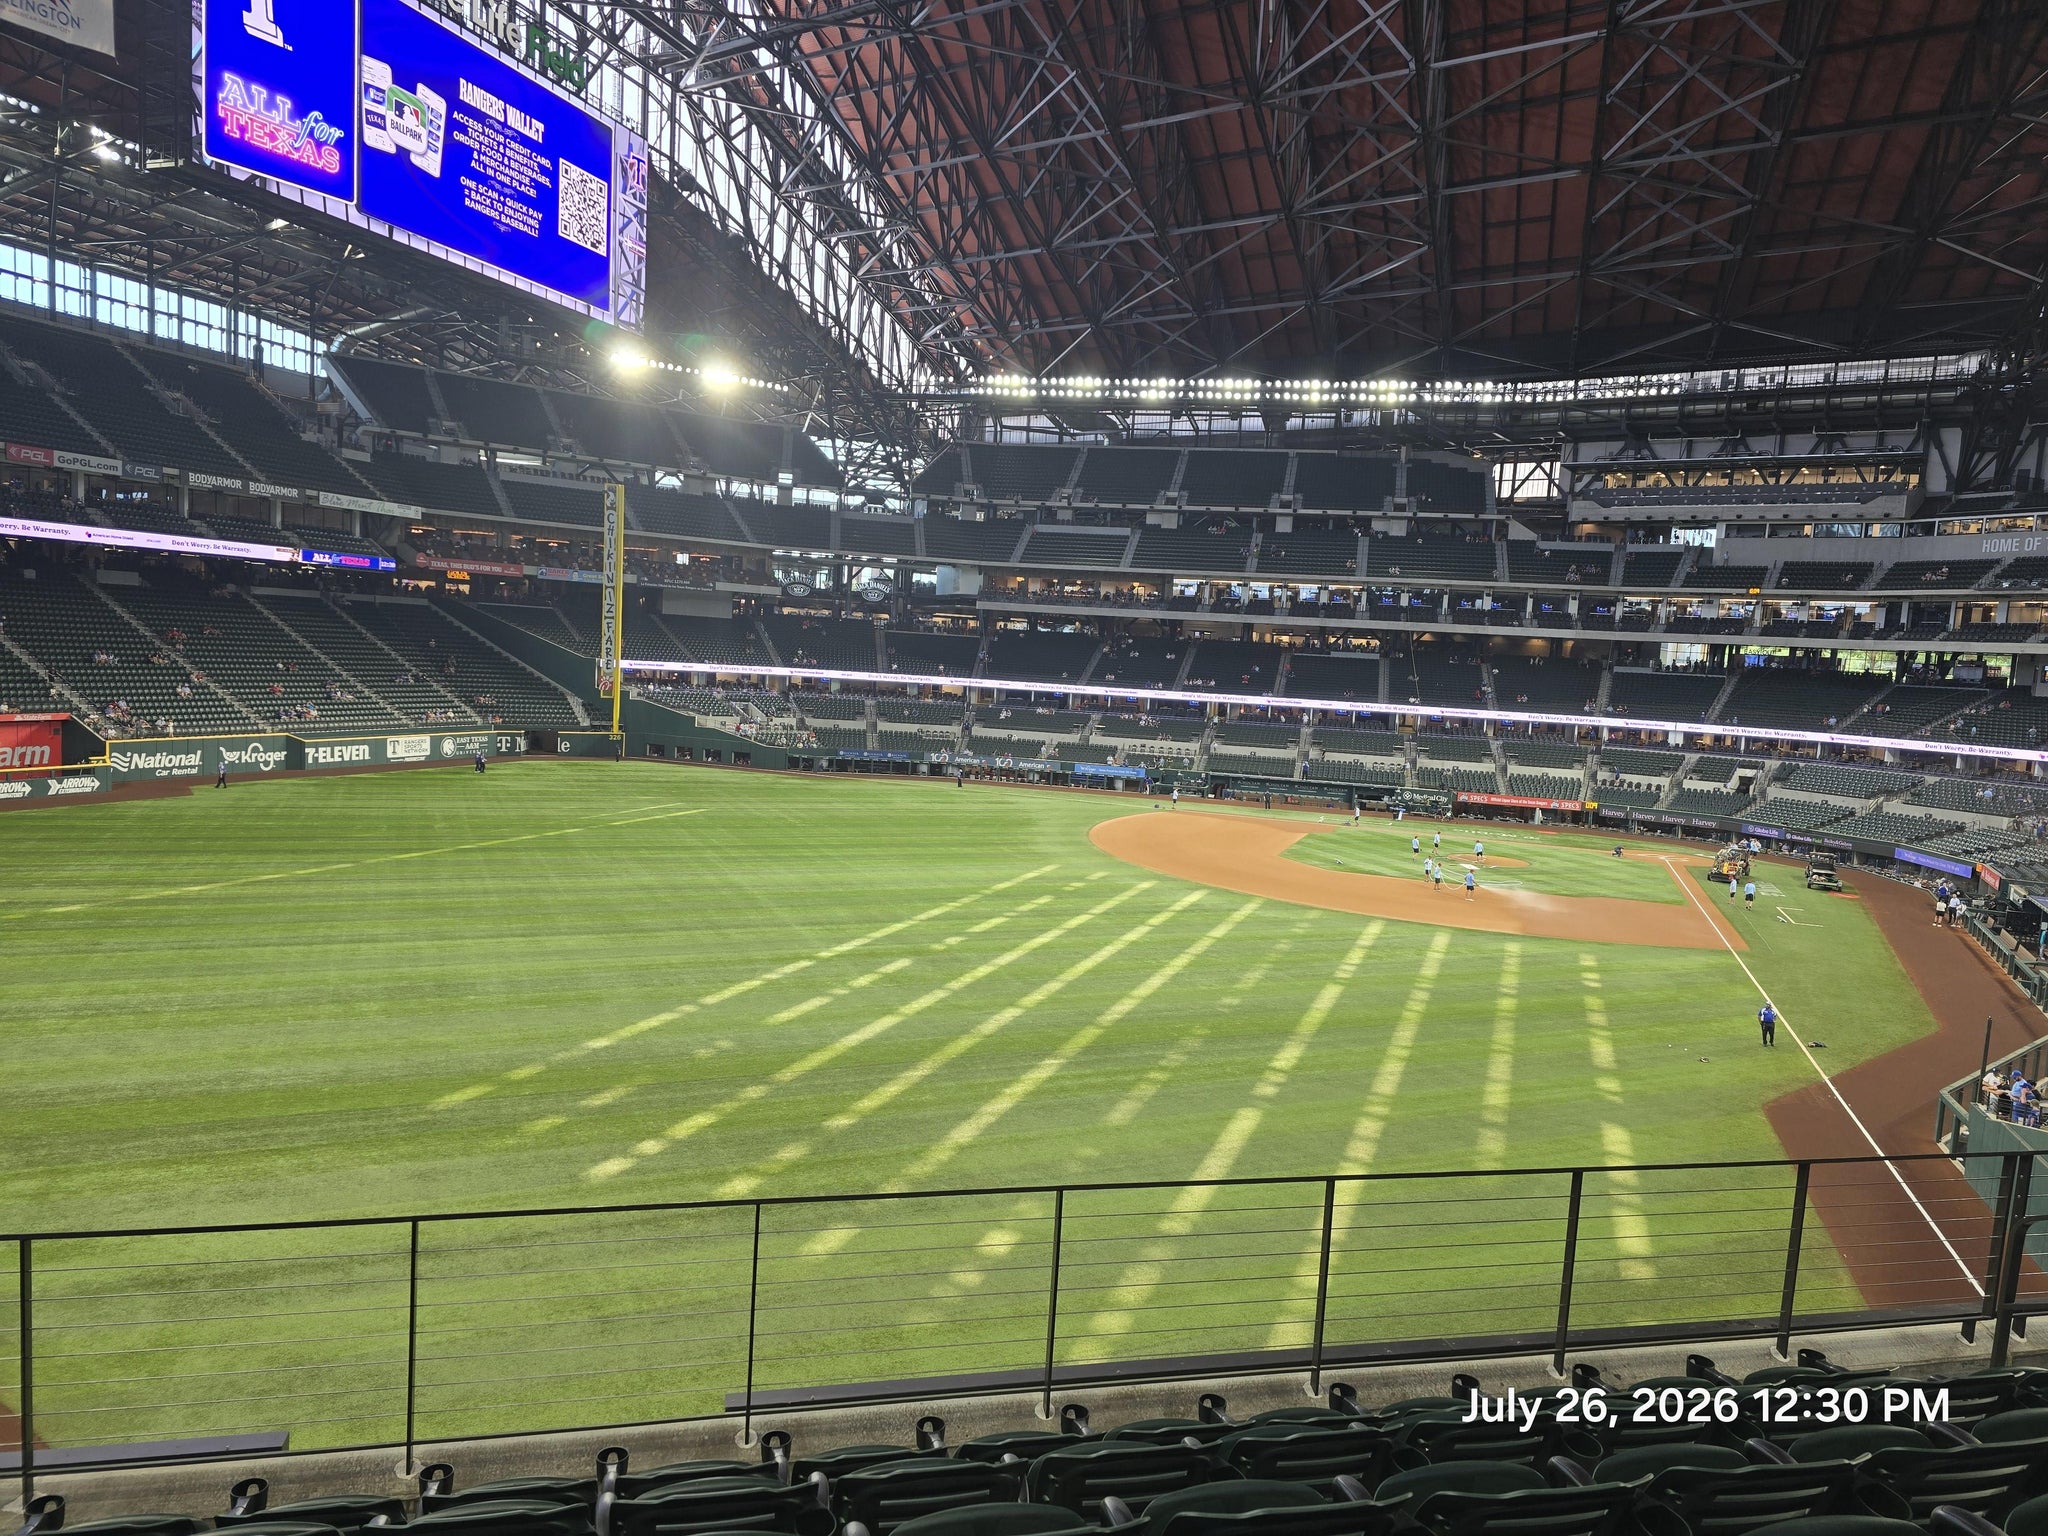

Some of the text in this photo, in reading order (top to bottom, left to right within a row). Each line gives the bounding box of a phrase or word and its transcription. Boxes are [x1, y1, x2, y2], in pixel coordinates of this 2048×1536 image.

[0, 0, 81, 30] LINGTON
[528, 24, 587, 89] Field
[218, 72, 345, 148] ALL for
[459, 77, 545, 143] RANGERS WALLET
[218, 103, 340, 174] TEXAS
[390, 119, 423, 144] BALLPARK
[452, 110, 552, 171] ACCESS YOUR CREDIT CARD,
[467, 127, 540, 173] TICKETS & BENEFITS,
[453, 130, 552, 189] ORDER FOOD & BEVERAGES,
[472, 150, 478, 160] &
[480, 153, 530, 186] MERCHANDISE
[470, 159, 537, 199] ALL IN ONE PLACE!
[460, 175, 477, 191] ONE
[478, 184, 499, 201] SCAN
[505, 197, 528, 215] QUICK
[528, 207, 543, 221] PAY
[464, 197, 539, 238] RANGERS BASEBALL!
[470, 190, 491, 207] BACK
[492, 200, 503, 212] TO
[504, 206, 539, 229] ENJOYING
[20, 449, 50, 463] PGL
[57, 455, 119, 473] GoPGL.com
[134, 466, 160, 479] PGL
[188, 472, 243, 490] BODYARMOR
[248, 481, 299, 498] BODYARMOR
[320, 492, 345, 507] Blue
[0, 523, 71, 536] orry. Be Warranty.
[171, 538, 190, 547] Don't
[190, 541, 212, 550] Worry.
[221, 544, 252, 554] Warranty.
[1982, 538, 2020, 553] HOME
[2024, 537, 2042, 551] OF
[312, 552, 332, 564] ALL
[430, 560, 449, 569] TEXAS,
[449, 562, 463, 570] THIS
[856, 581, 869, 592] JACK
[605, 590, 615, 614] IZ
[604, 621, 614, 671] FARE
[389, 739, 400, 755] T
[465, 742, 480, 750] A&M
[471, 735, 489, 743] TEXAS
[0, 744, 51, 767] arm
[241, 742, 287, 771] Kroger
[1944, 744, 1966, 752] Worry.
[1978, 747, 2013, 756] Warranty.
[130, 750, 201, 770] National
[954, 756, 980, 764] American
[1018, 761, 1045, 769] American
[155, 766, 199, 777] Car Rental
[0, 780, 23, 794] RROW
[60, 776, 94, 789] ARROW
[1412, 792, 1449, 803] Medical City
[1469, 794, 1488, 803] SPEC'S
[1560, 801, 1580, 809] SPEC'S
[1602, 808, 1625, 818] Harvey
[1632, 811, 1656, 821] Harvey
[1662, 814, 1686, 824] Harvey
[1692, 818, 1717, 828] Harvey
[1768, 828, 1779, 836] Life
